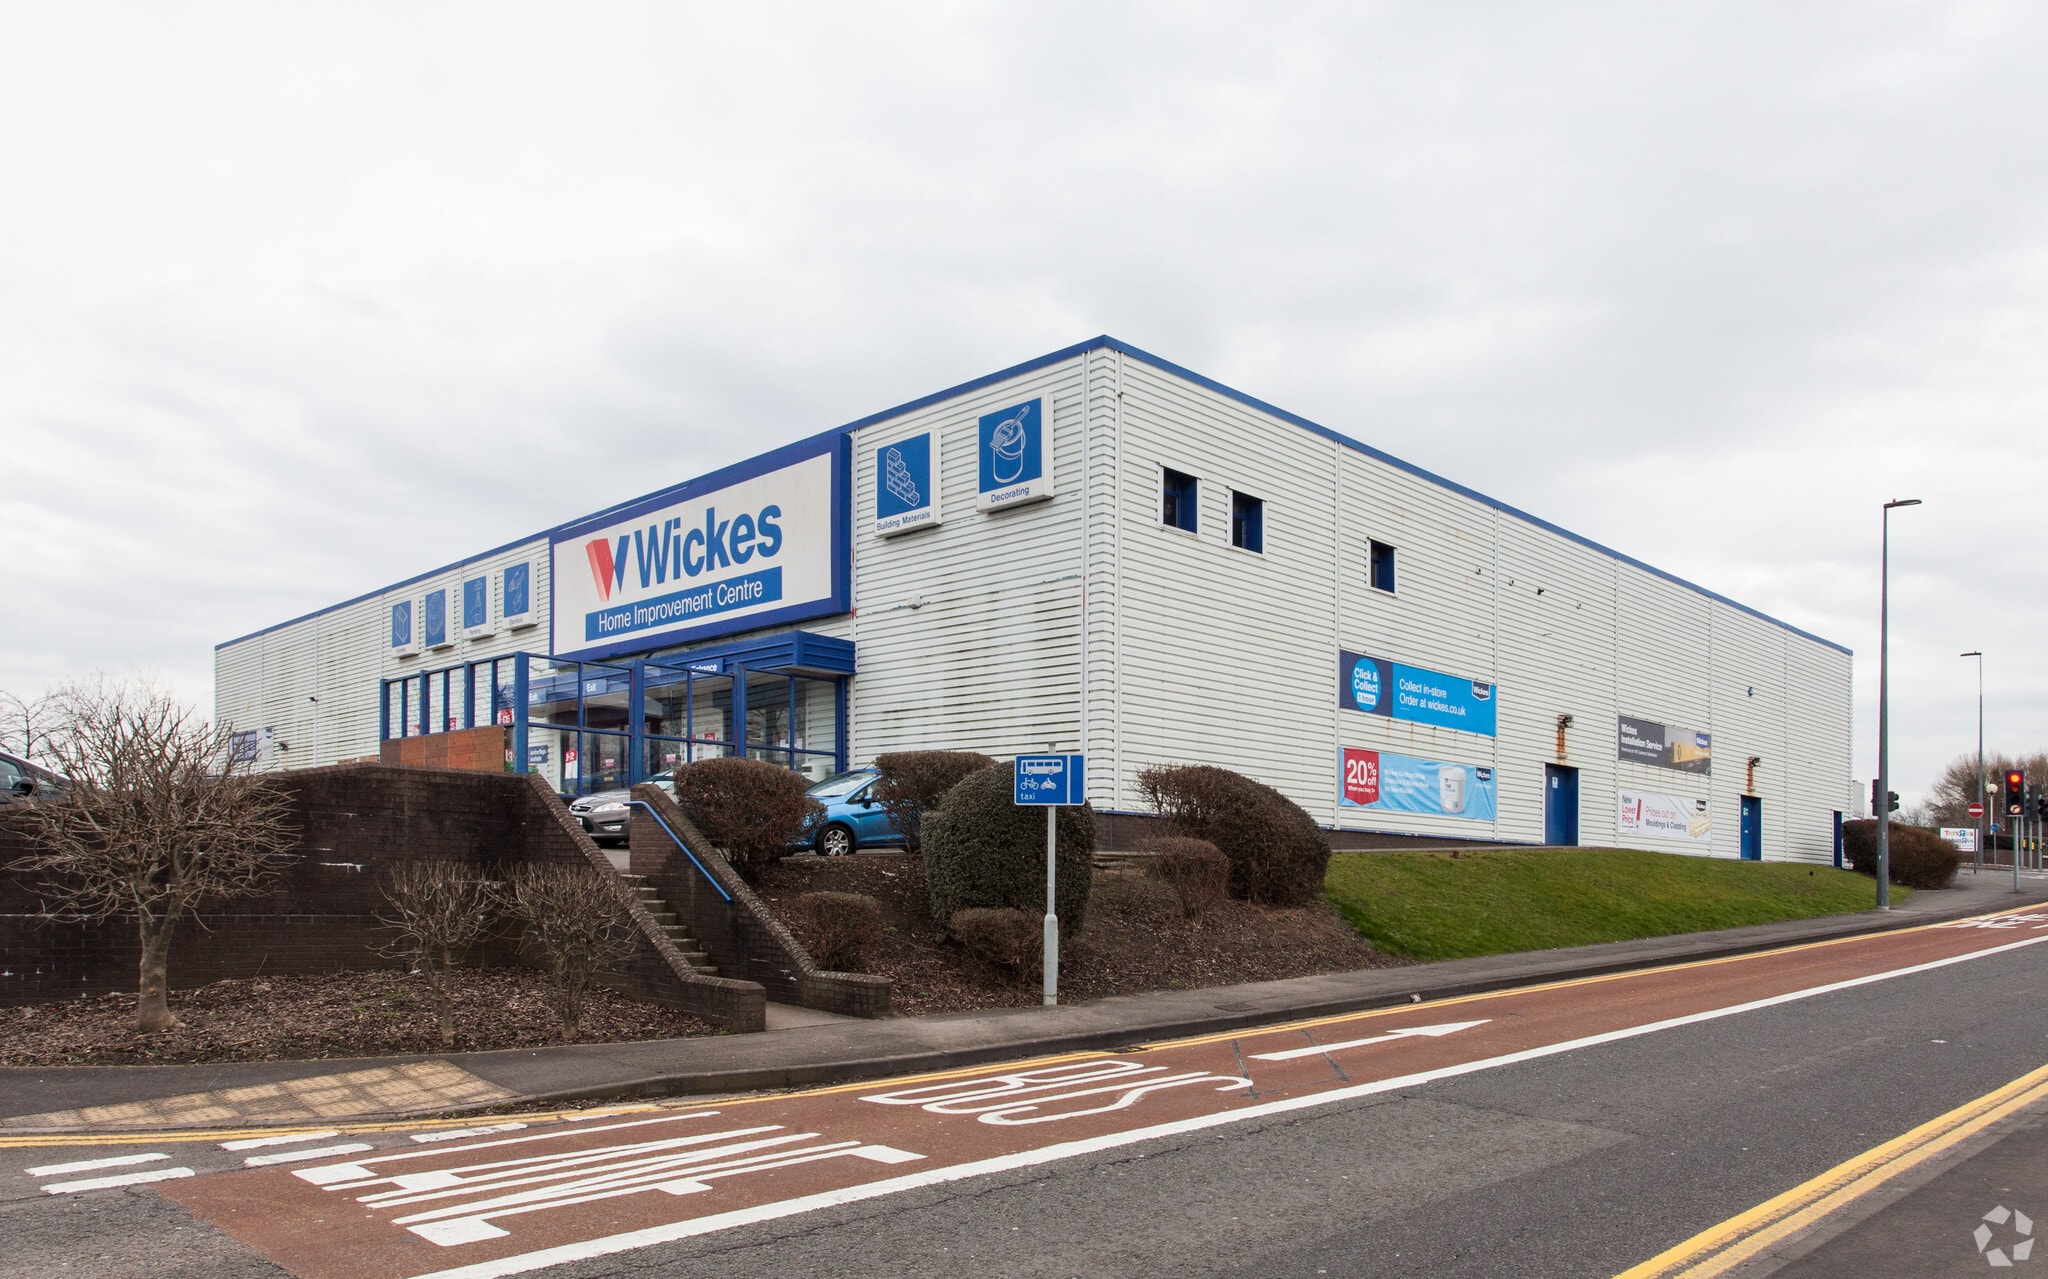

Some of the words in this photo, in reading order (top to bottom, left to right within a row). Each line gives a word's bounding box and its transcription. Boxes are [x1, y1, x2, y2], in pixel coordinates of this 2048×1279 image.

[990, 486, 1030, 502] Decorating
[878, 518, 900, 530] Building
[902, 512, 930, 524] Materials
[634, 504, 783, 589] Wickes
[598, 610, 631, 633] Home
[634, 591, 713, 626] Improvement
[716, 580, 763, 606] Centre
[1354, 668, 1372, 680] Click
[1372, 671, 1379, 683] &
[1354, 678, 1378, 694] Collect
[1400, 678, 1422, 694] Collect
[1424, 684, 1448, 698] in-store
[1400, 692, 1418, 706] Order
[1419, 698, 1427, 708] at
[1428, 700, 1466, 716] wickes.co.uk
[1622, 724, 1638, 736] Wickes
[1622, 734, 1646, 748] Installation
[1646, 740, 1662, 750] Service
[1347, 758, 1377, 785] 20%
[1368, 776, 1376, 786] off
[1646, 818, 1666, 830] Mouldings
[858, 1059, 1253, 1126] BUS
[291, 1111, 928, 1247] LANE
